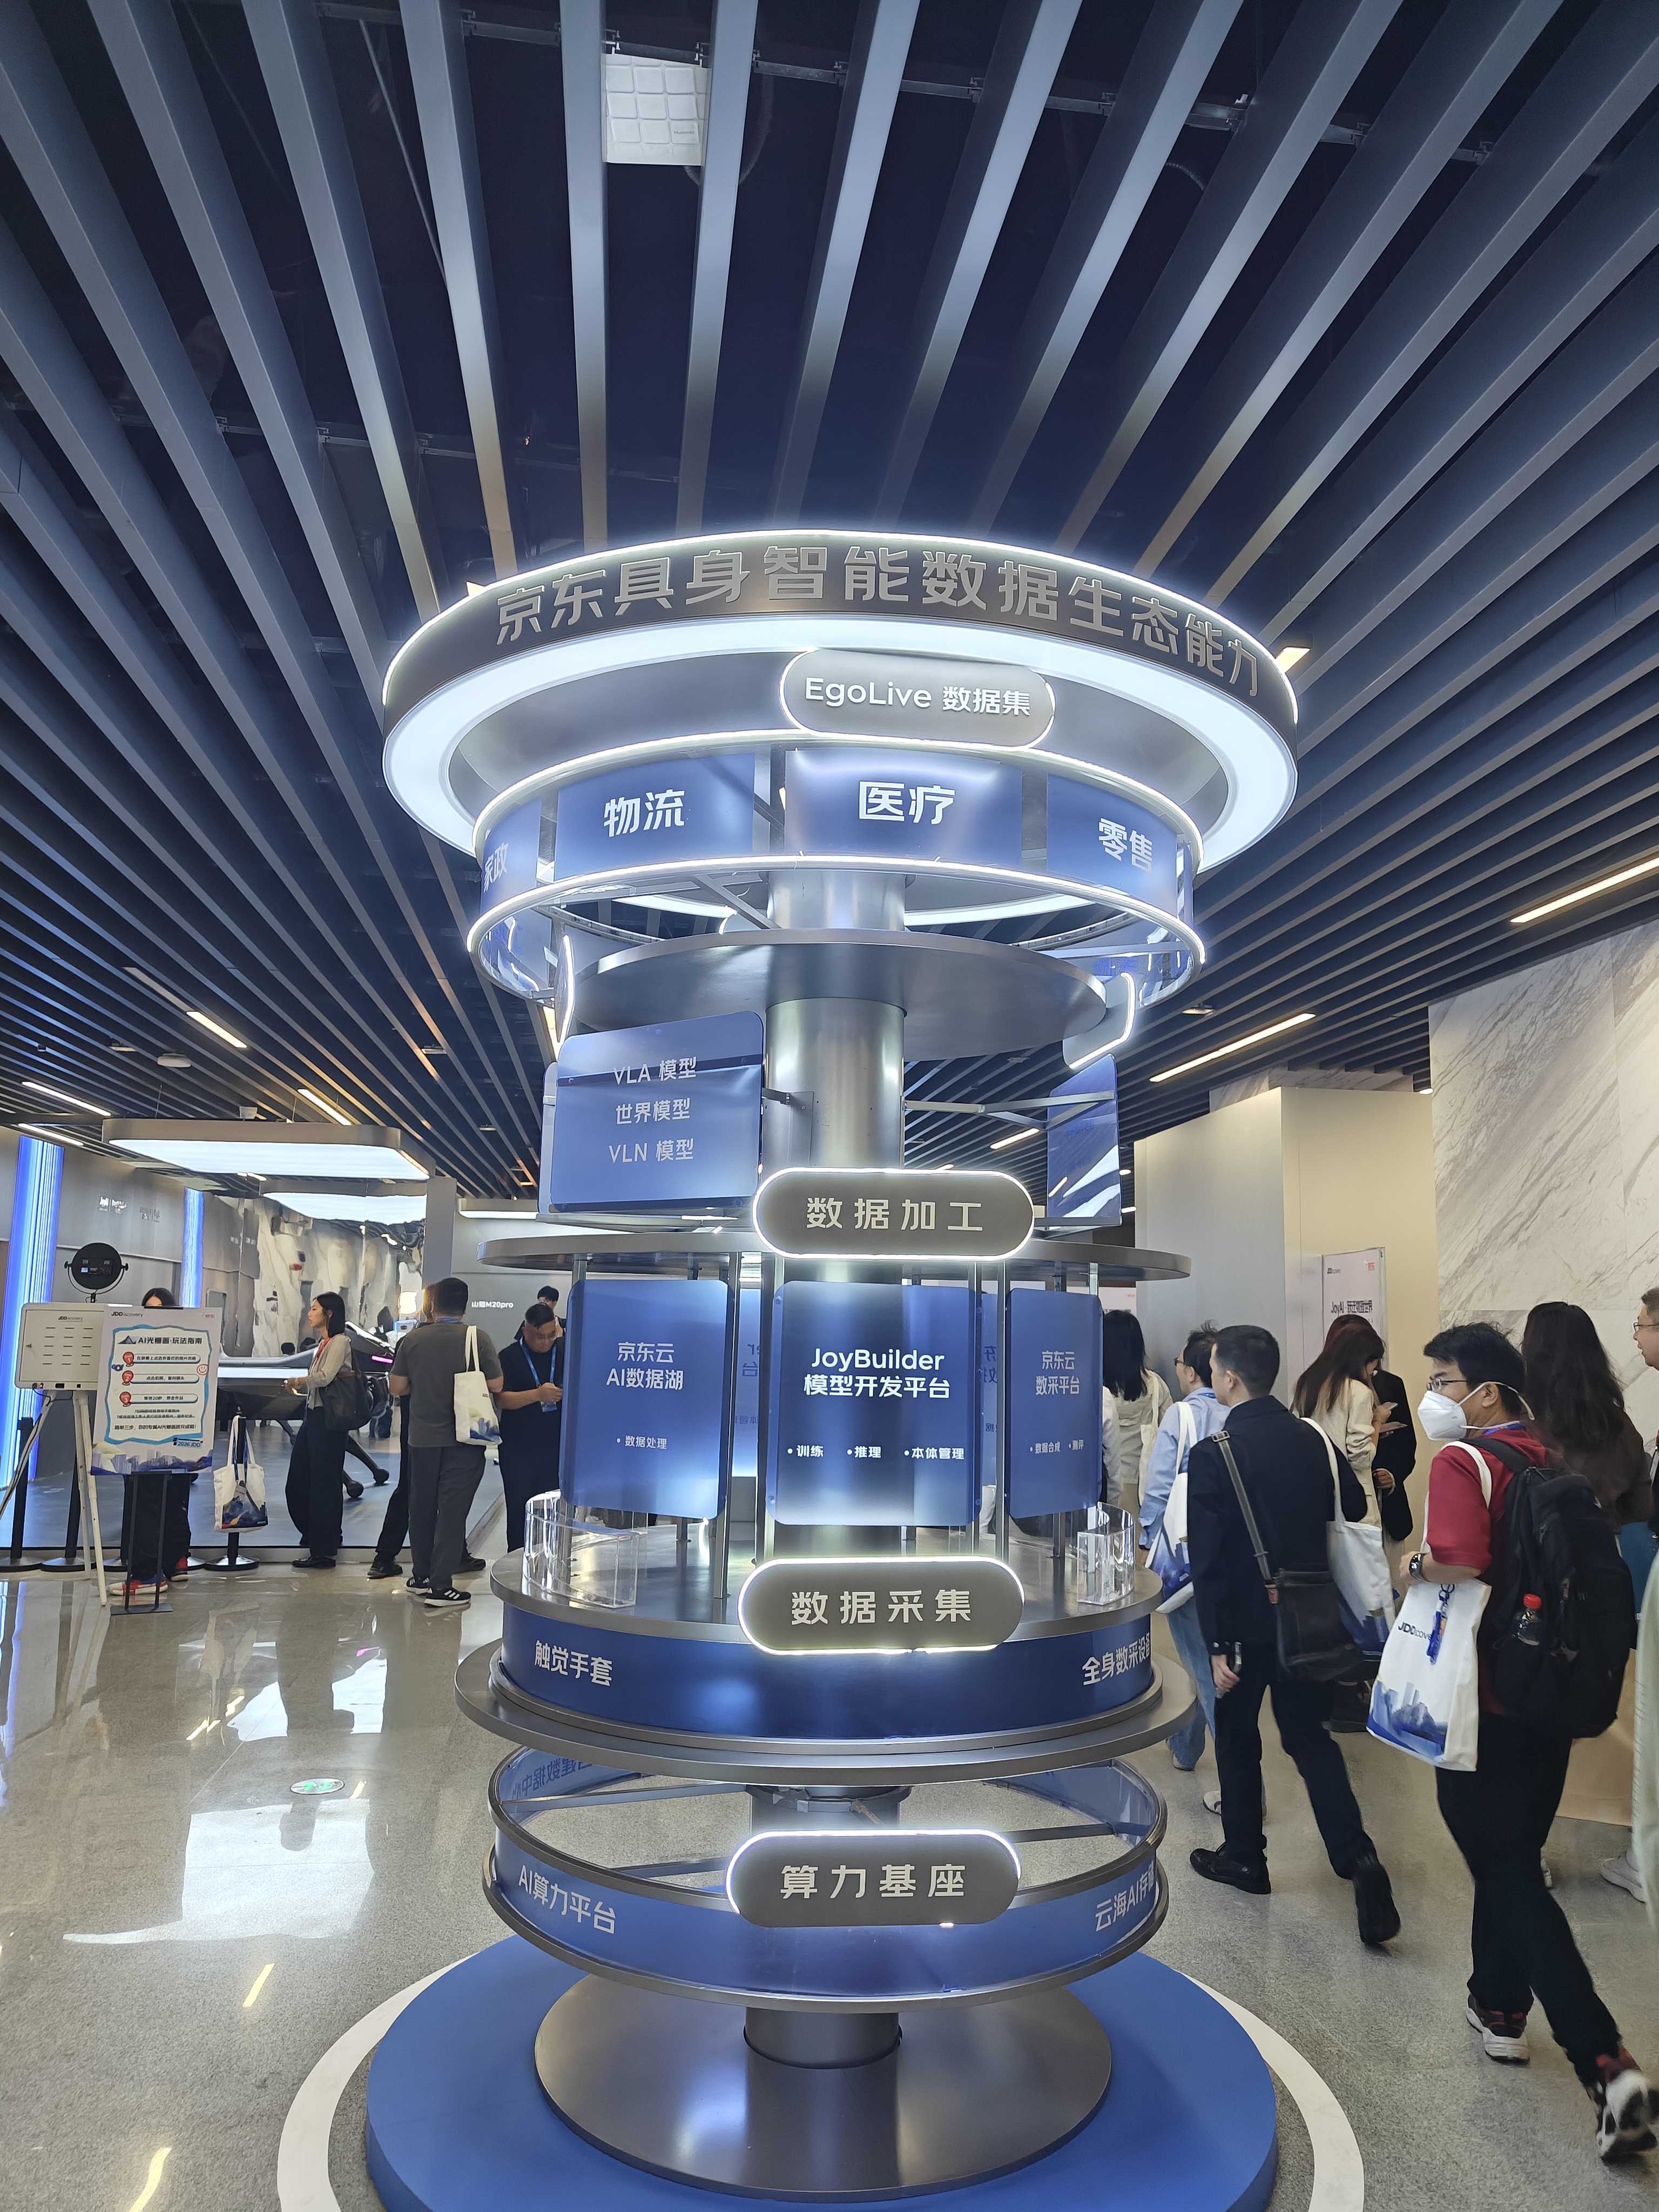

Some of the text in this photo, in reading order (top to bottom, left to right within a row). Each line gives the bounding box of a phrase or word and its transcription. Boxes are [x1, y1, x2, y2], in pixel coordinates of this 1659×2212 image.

[496, 545, 1258, 698] 京东具身智能数据生态能力
[806, 677, 1031, 717] EgoLive 数据集
[604, 789, 685, 837] 物流
[859, 781, 955, 825] 医疗
[1098, 817, 1154, 873] 零售
[484, 842, 509, 893] 家政
[613, 1056, 697, 1085] VLA 模型
[616, 1098, 690, 1124] 世界模型
[609, 1138, 694, 1163] VLN 模型
[806, 1197, 983, 1231] 数据加工
[617, 1341, 675, 1363] 京东云
[811, 1348, 945, 1372] JoyBuilder
[1042, 1351, 1075, 1370] 京东云
[606, 1368, 684, 1391] AI数据湖
[804, 1374, 950, 1399] 模型开发平台
[1035, 1375, 1080, 1395] 数采平台
[625, 1435, 667, 1449] 数据处理
[797, 1445, 965, 1460] 训练 推理 本体管理
[1035, 1439, 1084, 1453] 数据合成 测评
[791, 1589, 972, 1626] 数据采集
[534, 1639, 613, 1686] 触觉手套
[1082, 1632, 1150, 1685] 全身数采设备
[780, 1863, 966, 1899] 算力基座
[1095, 1860, 1154, 1932] 云海AI存储
[518, 1864, 617, 1934] AI算力平台
